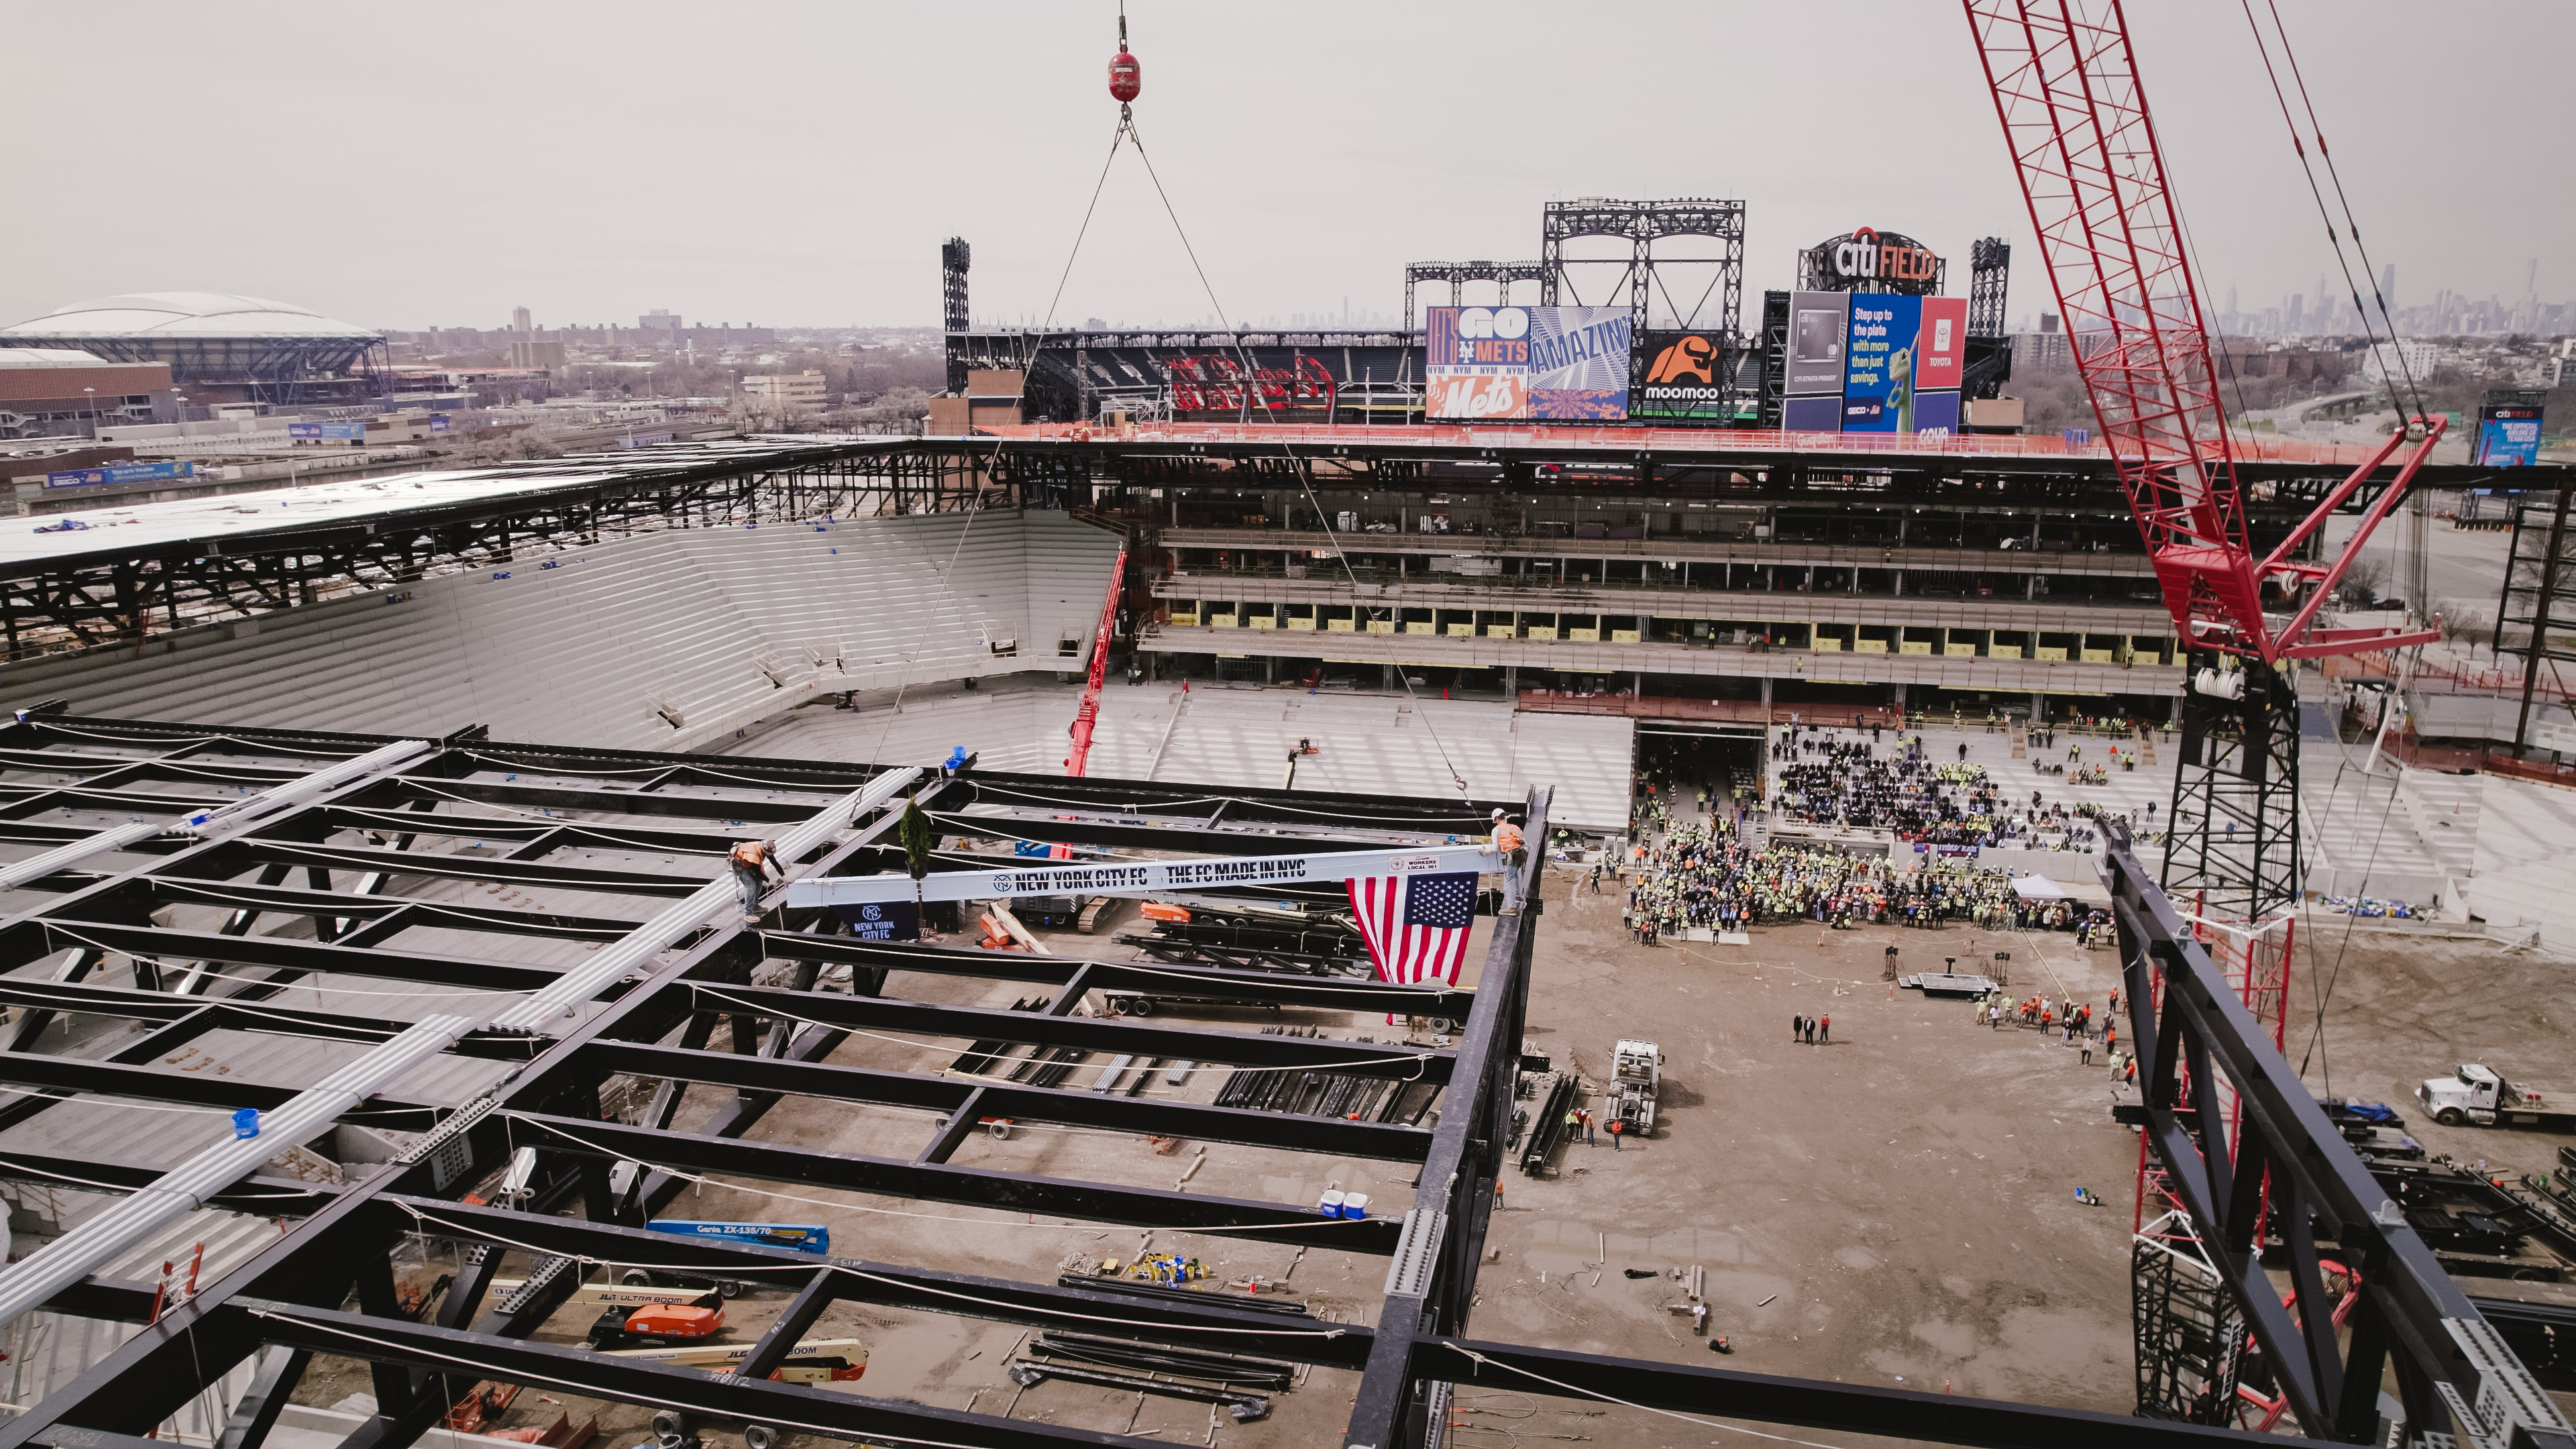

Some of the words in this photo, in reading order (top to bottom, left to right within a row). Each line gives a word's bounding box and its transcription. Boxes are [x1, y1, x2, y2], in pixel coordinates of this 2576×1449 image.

[1836, 234, 1877, 278] citi
[1880, 246, 1935, 280] FIELD
[1458, 307, 1529, 339] GO
[1854, 307, 1873, 323] Step
[1873, 311, 1883, 323] up
[1884, 309, 1892, 321] to
[1428, 308, 1459, 364] LET'S
[1854, 323, 1867, 336] the
[1868, 323, 1886, 339] plate
[1476, 341, 1528, 362] METS
[1853, 339, 1870, 352] with
[1870, 341, 1890, 352] more
[1851, 354, 1869, 368] than
[1869, 354, 1884, 370] just
[1929, 357, 1951, 367] TOYOTA
[1428, 366, 1445, 374] NYM
[1454, 366, 1471, 374] NYM
[1480, 366, 1497, 375] NYM
[1506, 366, 1524, 375] NYM
[1849, 370, 1879, 386] savings.
[1442, 376, 1513, 418] Mets
[1646, 387, 1719, 399] moomoo
[2496, 409, 2511, 418] citi
[1015, 873, 1050, 892] NEW
[1053, 870, 1094, 890] YORK
[1095, 868, 1127, 888] CITY
[1130, 867, 1148, 885] FC
[1166, 865, 1193, 884] THE
[1195, 864, 1212, 883] FC
[1215, 862, 1258, 881] MADE
[1259, 861, 1275, 879] IN
[1277, 859, 1306, 877] NYC
[854, 922, 872, 932] NEW
[873, 920, 895, 930] YORK
[862, 930, 879, 939] CITY
[879, 930, 890, 939] FC
[697, 1225, 721, 1234] Genie
[723, 1226, 771, 1234] ZX-135/70
[727, 1350, 749, 1358] JLG
